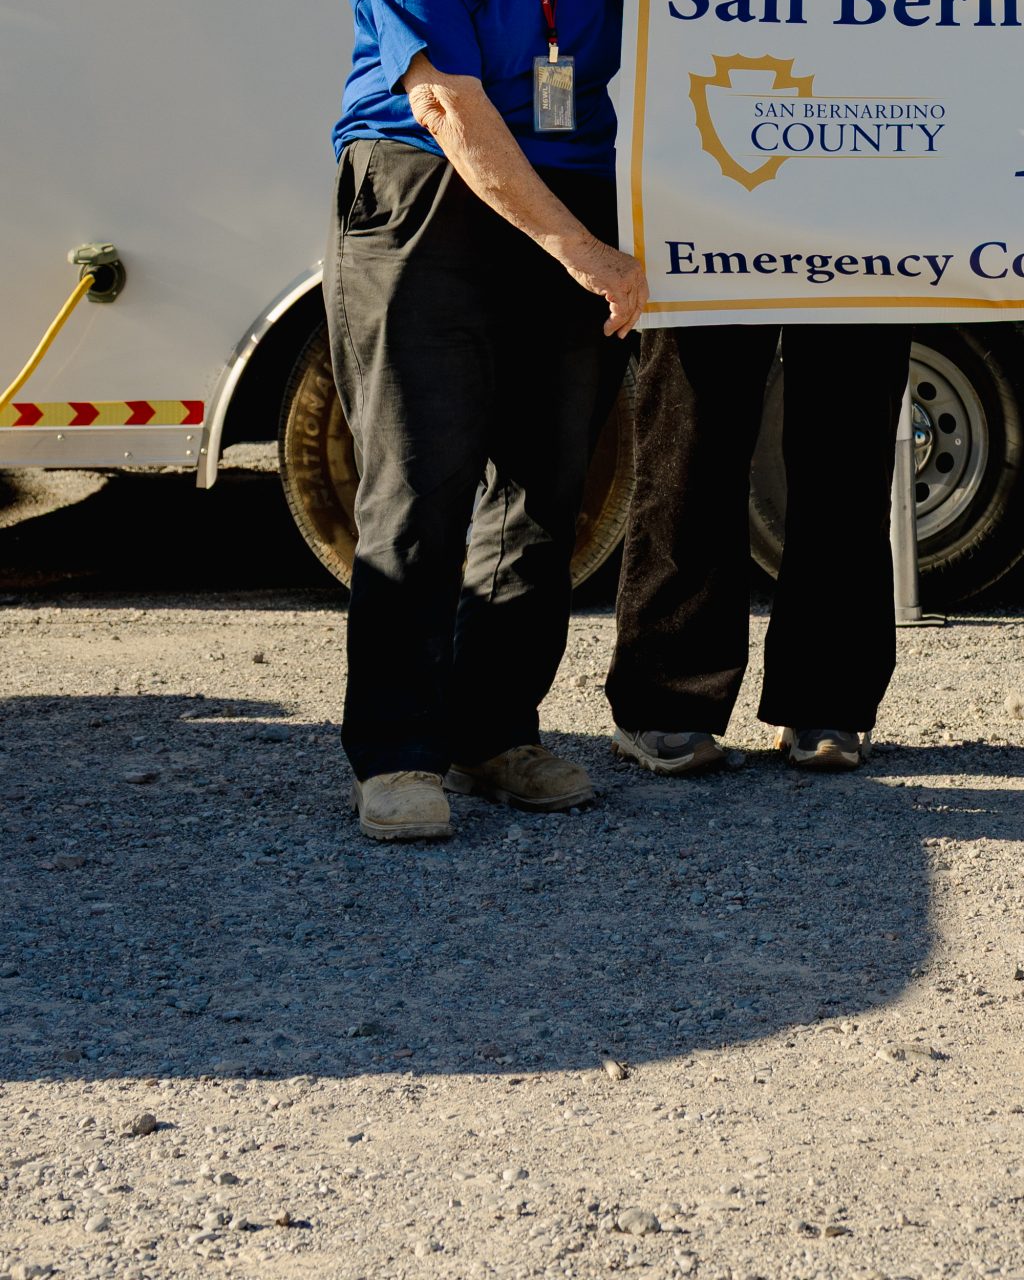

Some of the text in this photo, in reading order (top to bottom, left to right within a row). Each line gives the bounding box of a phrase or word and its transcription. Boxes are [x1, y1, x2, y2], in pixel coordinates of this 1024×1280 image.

[754, 103, 946, 119] SAN BERNARDINO
[750, 122, 946, 153] COUNTY
[665, 240, 954, 286] Emergency
